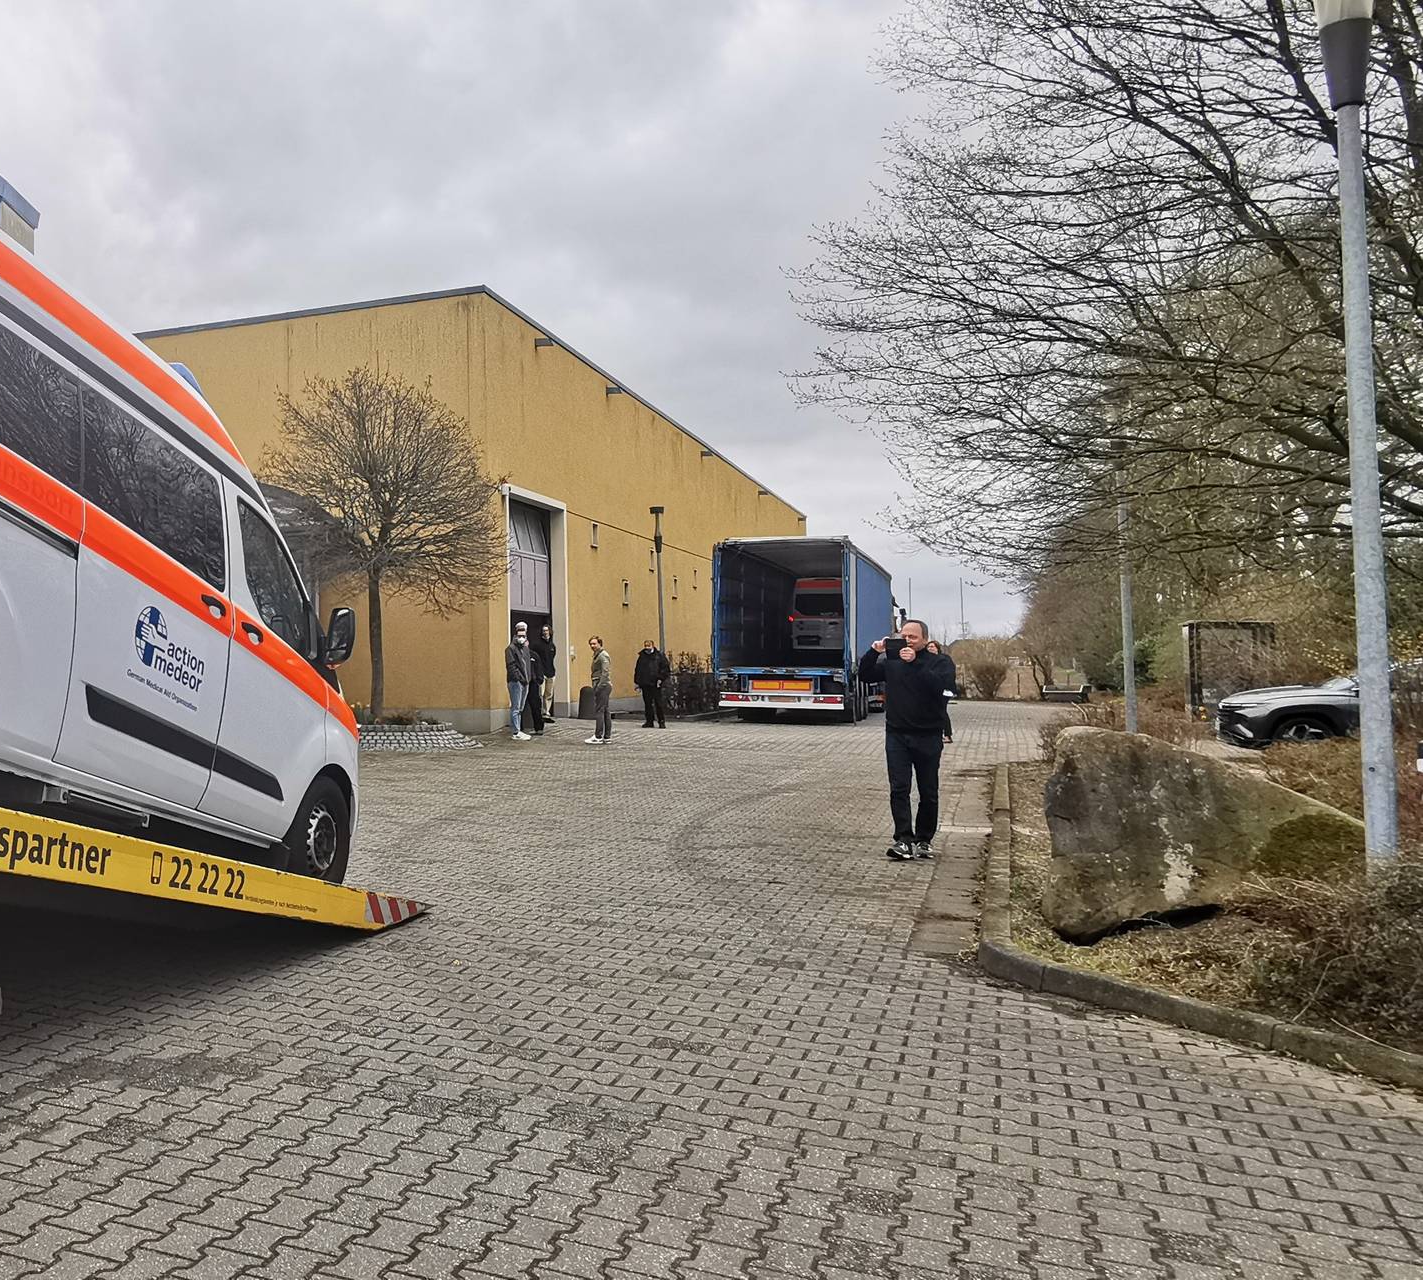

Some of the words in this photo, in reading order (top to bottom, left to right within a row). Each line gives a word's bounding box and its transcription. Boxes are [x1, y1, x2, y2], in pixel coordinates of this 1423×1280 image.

[154, 654, 203, 692] medeor
[167, 642, 205, 676] action
[145, 678, 164, 694] Medical
[168, 855, 193, 891] 22
[197, 862, 220, 896] 22
[224, 867, 246, 900] 22
